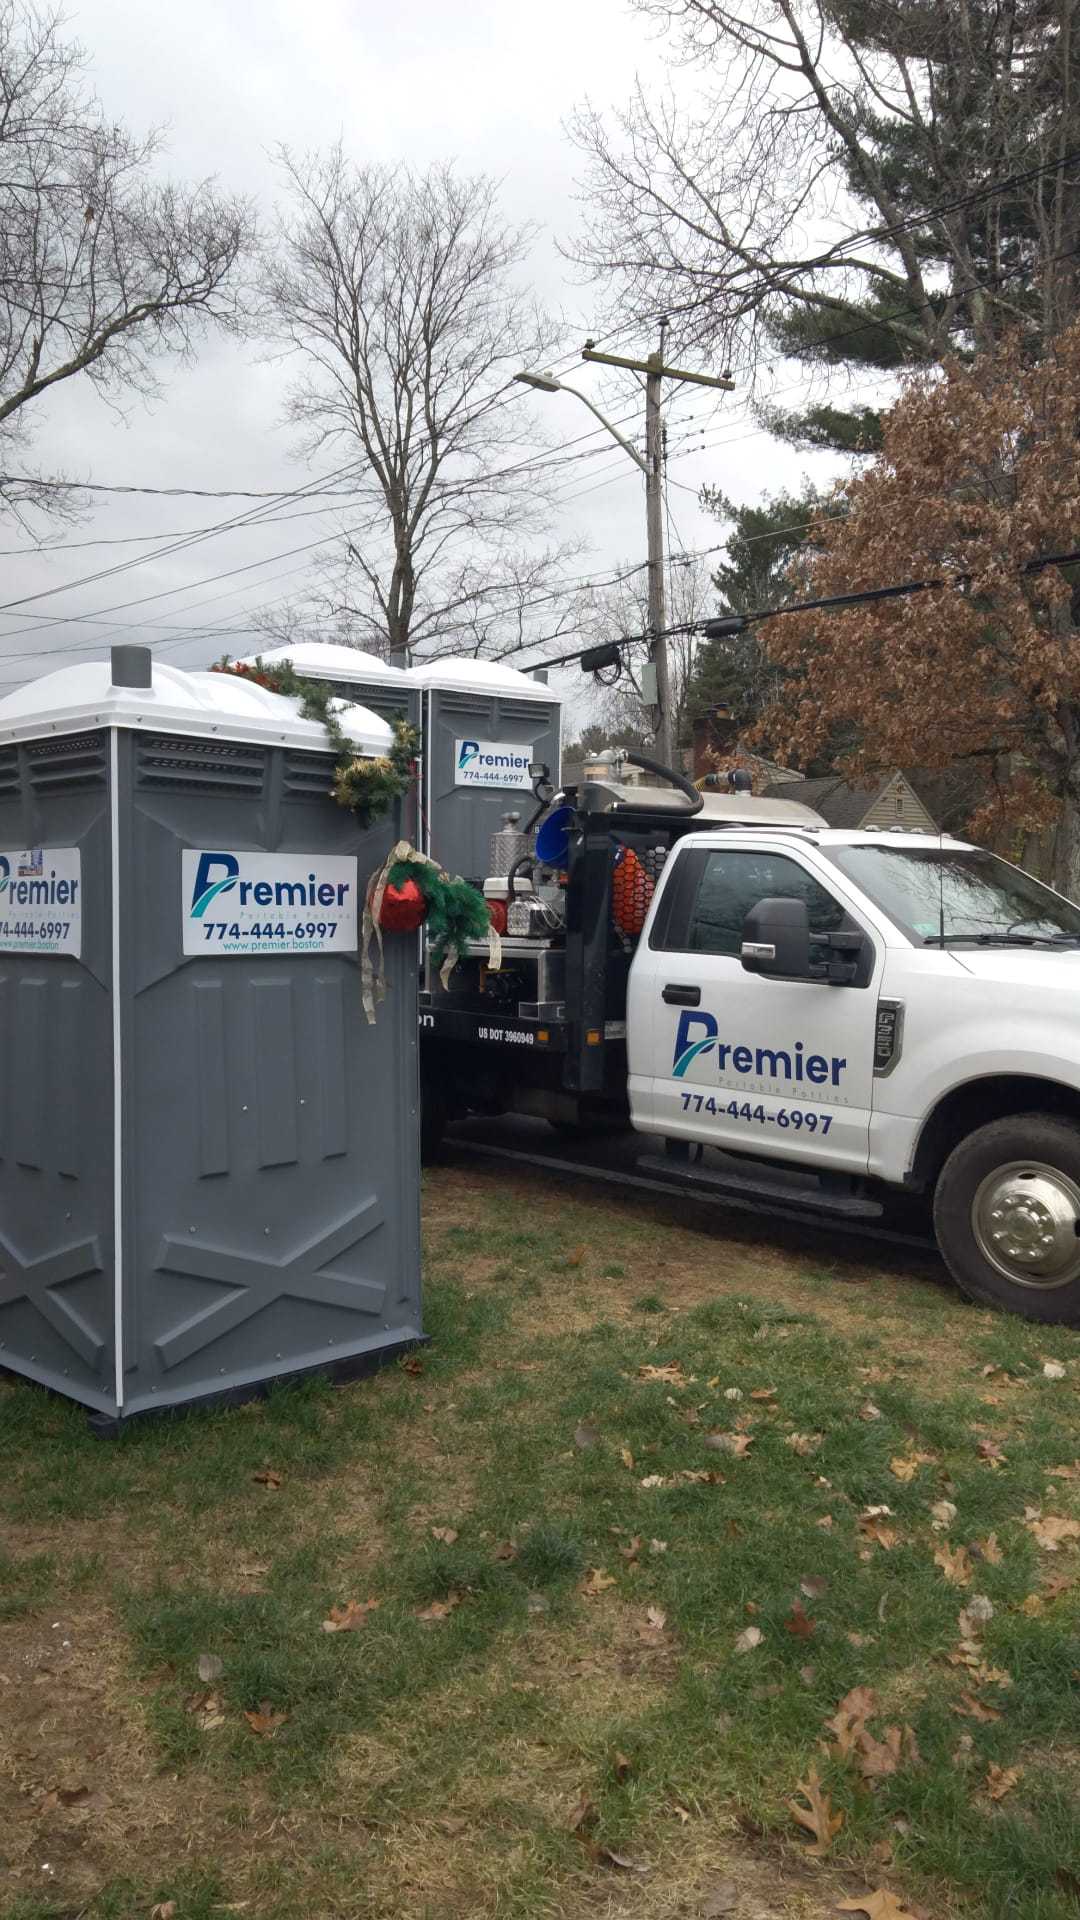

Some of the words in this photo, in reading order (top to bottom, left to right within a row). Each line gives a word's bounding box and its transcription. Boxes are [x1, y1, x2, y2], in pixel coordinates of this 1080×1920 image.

[459, 741, 529, 769] Premier
[464, 771, 524, 784] 774-444-6997
[191, 853, 350, 918] Premier
[203, 922, 338, 940] 774-444-6997
[223, 939, 325, 953] www.premier.boston
[478, 1026, 489, 1039] US
[489, 1027, 504, 1041] DOT
[672, 1010, 847, 1086] Premier
[719, 1076, 781, 1094] Portable
[792, 1087, 849, 1104] Potties
[681, 1092, 834, 1135] 774-444-6997
